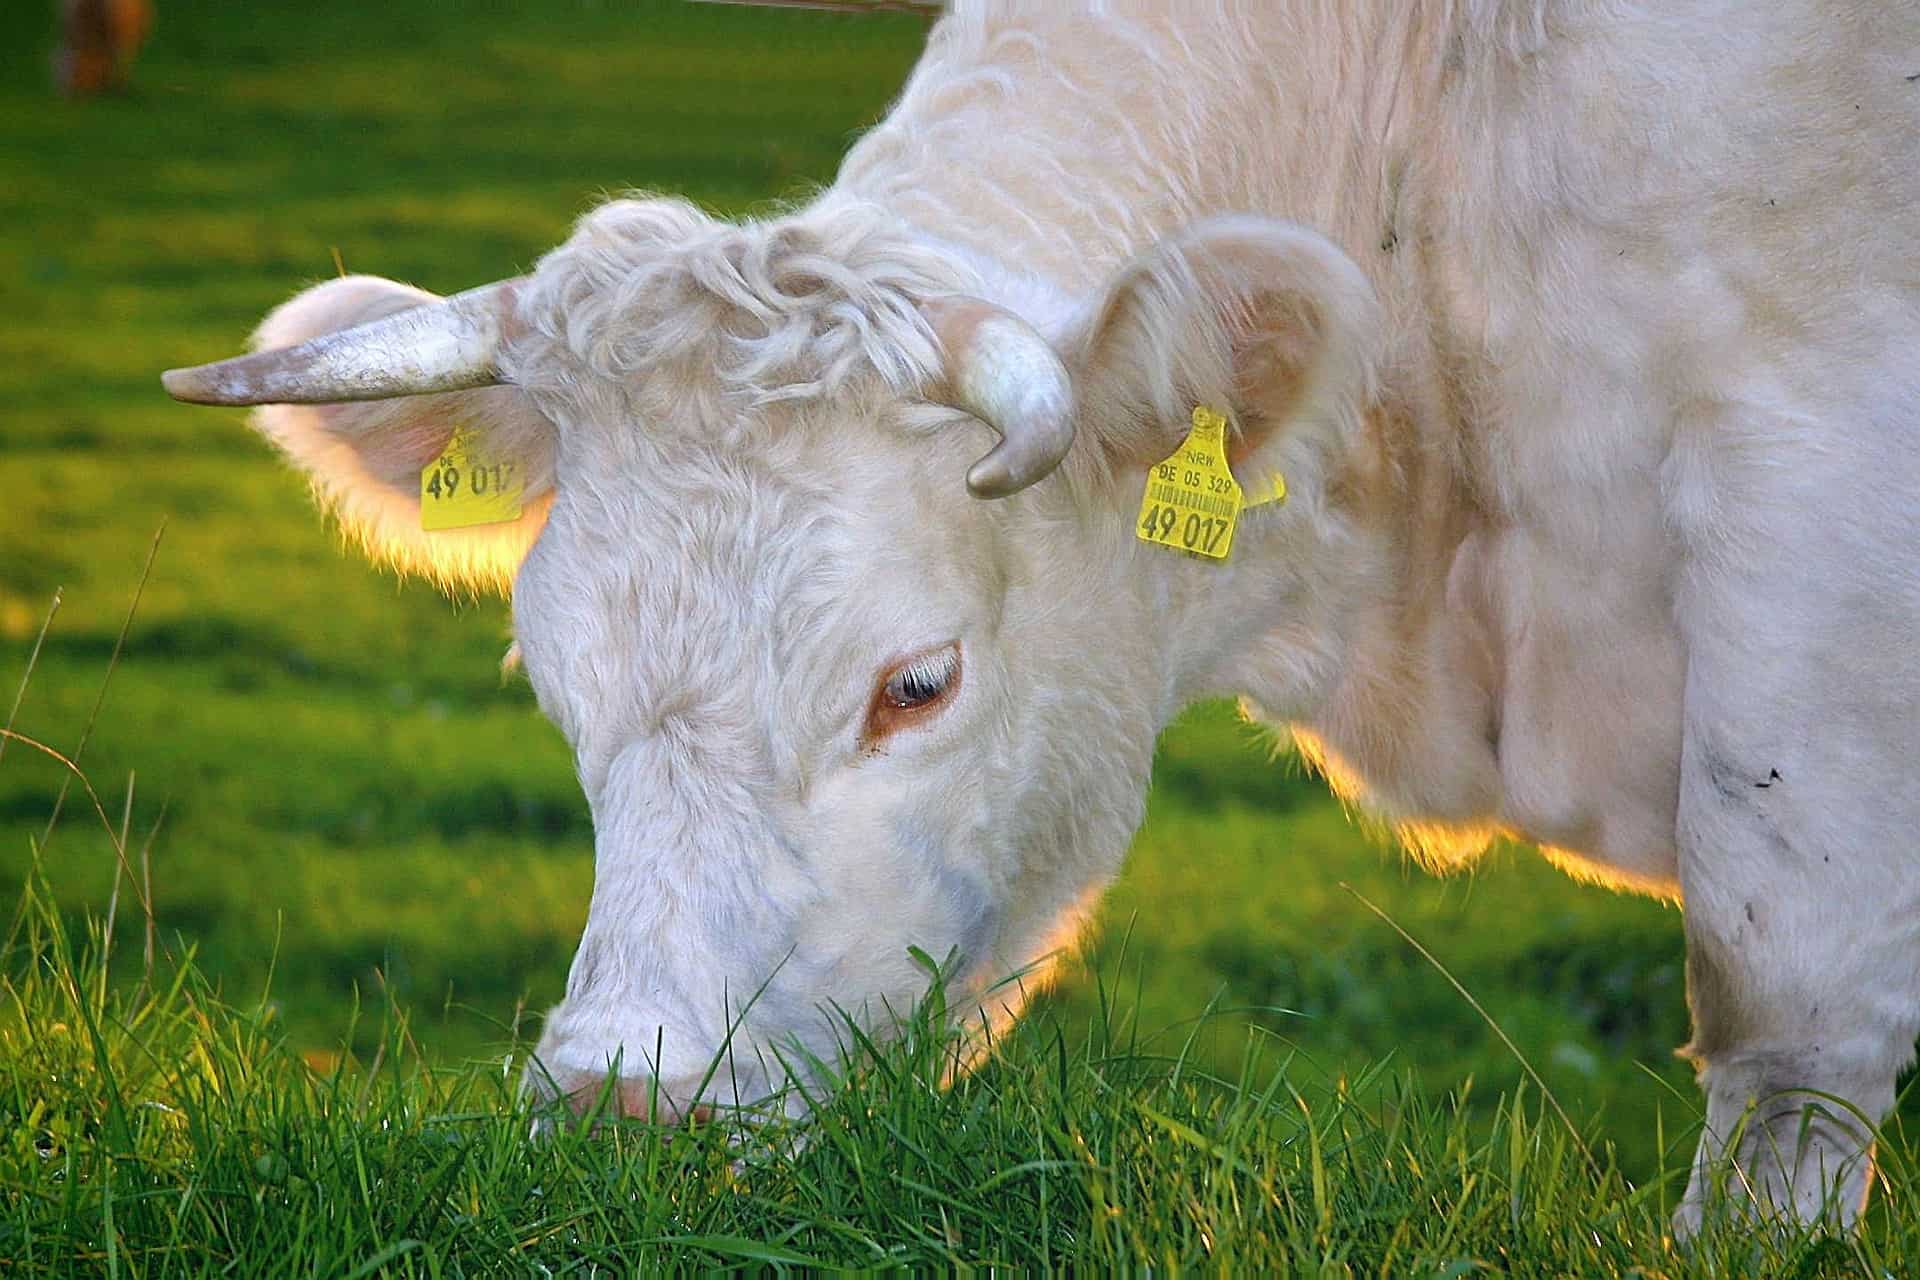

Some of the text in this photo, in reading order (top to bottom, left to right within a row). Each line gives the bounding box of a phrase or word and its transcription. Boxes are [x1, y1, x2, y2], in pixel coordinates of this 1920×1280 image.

[1187, 450, 1215, 467] NRW
[426, 468, 460, 500] 49
[1159, 463, 1232, 494] DE 05 329
[1142, 504, 1229, 553] 49 017
